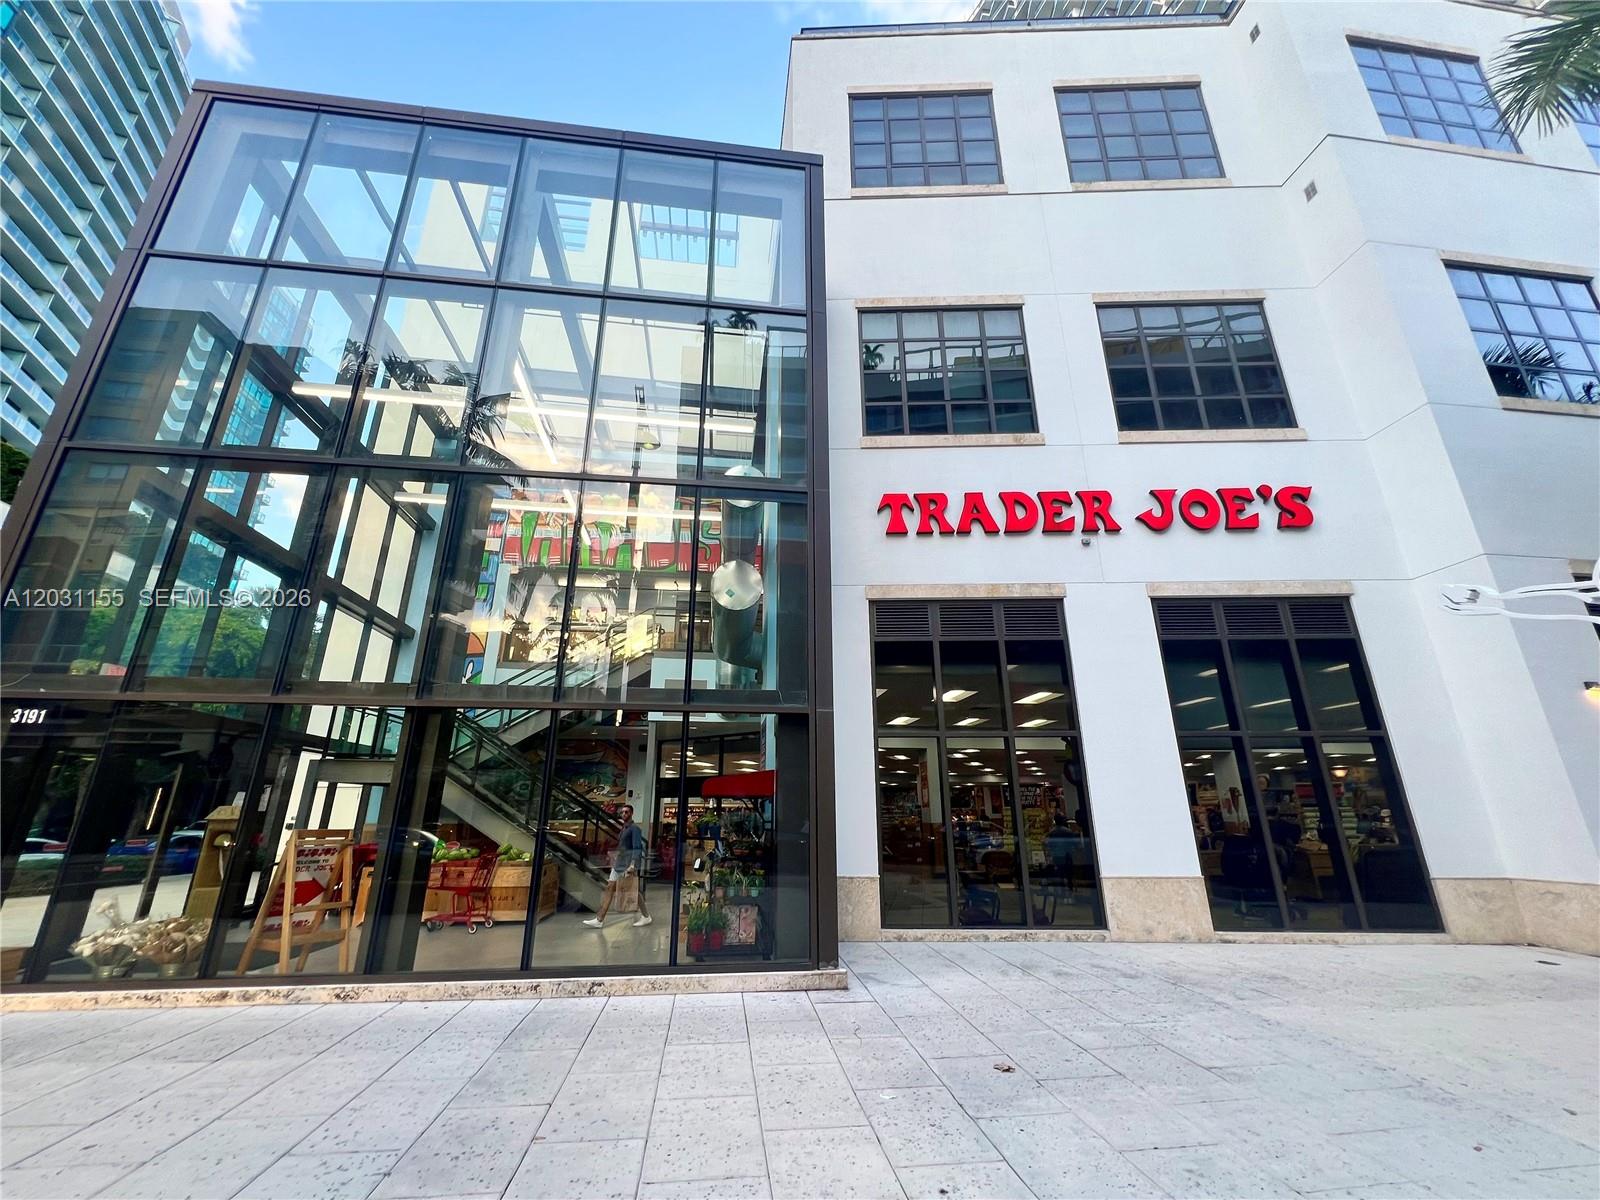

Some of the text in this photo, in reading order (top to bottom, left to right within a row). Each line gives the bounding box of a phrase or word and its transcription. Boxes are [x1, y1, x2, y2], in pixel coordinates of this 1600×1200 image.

[877, 485, 1314, 535] TRADER JOE'S
[10, 708, 48, 724] 3191
